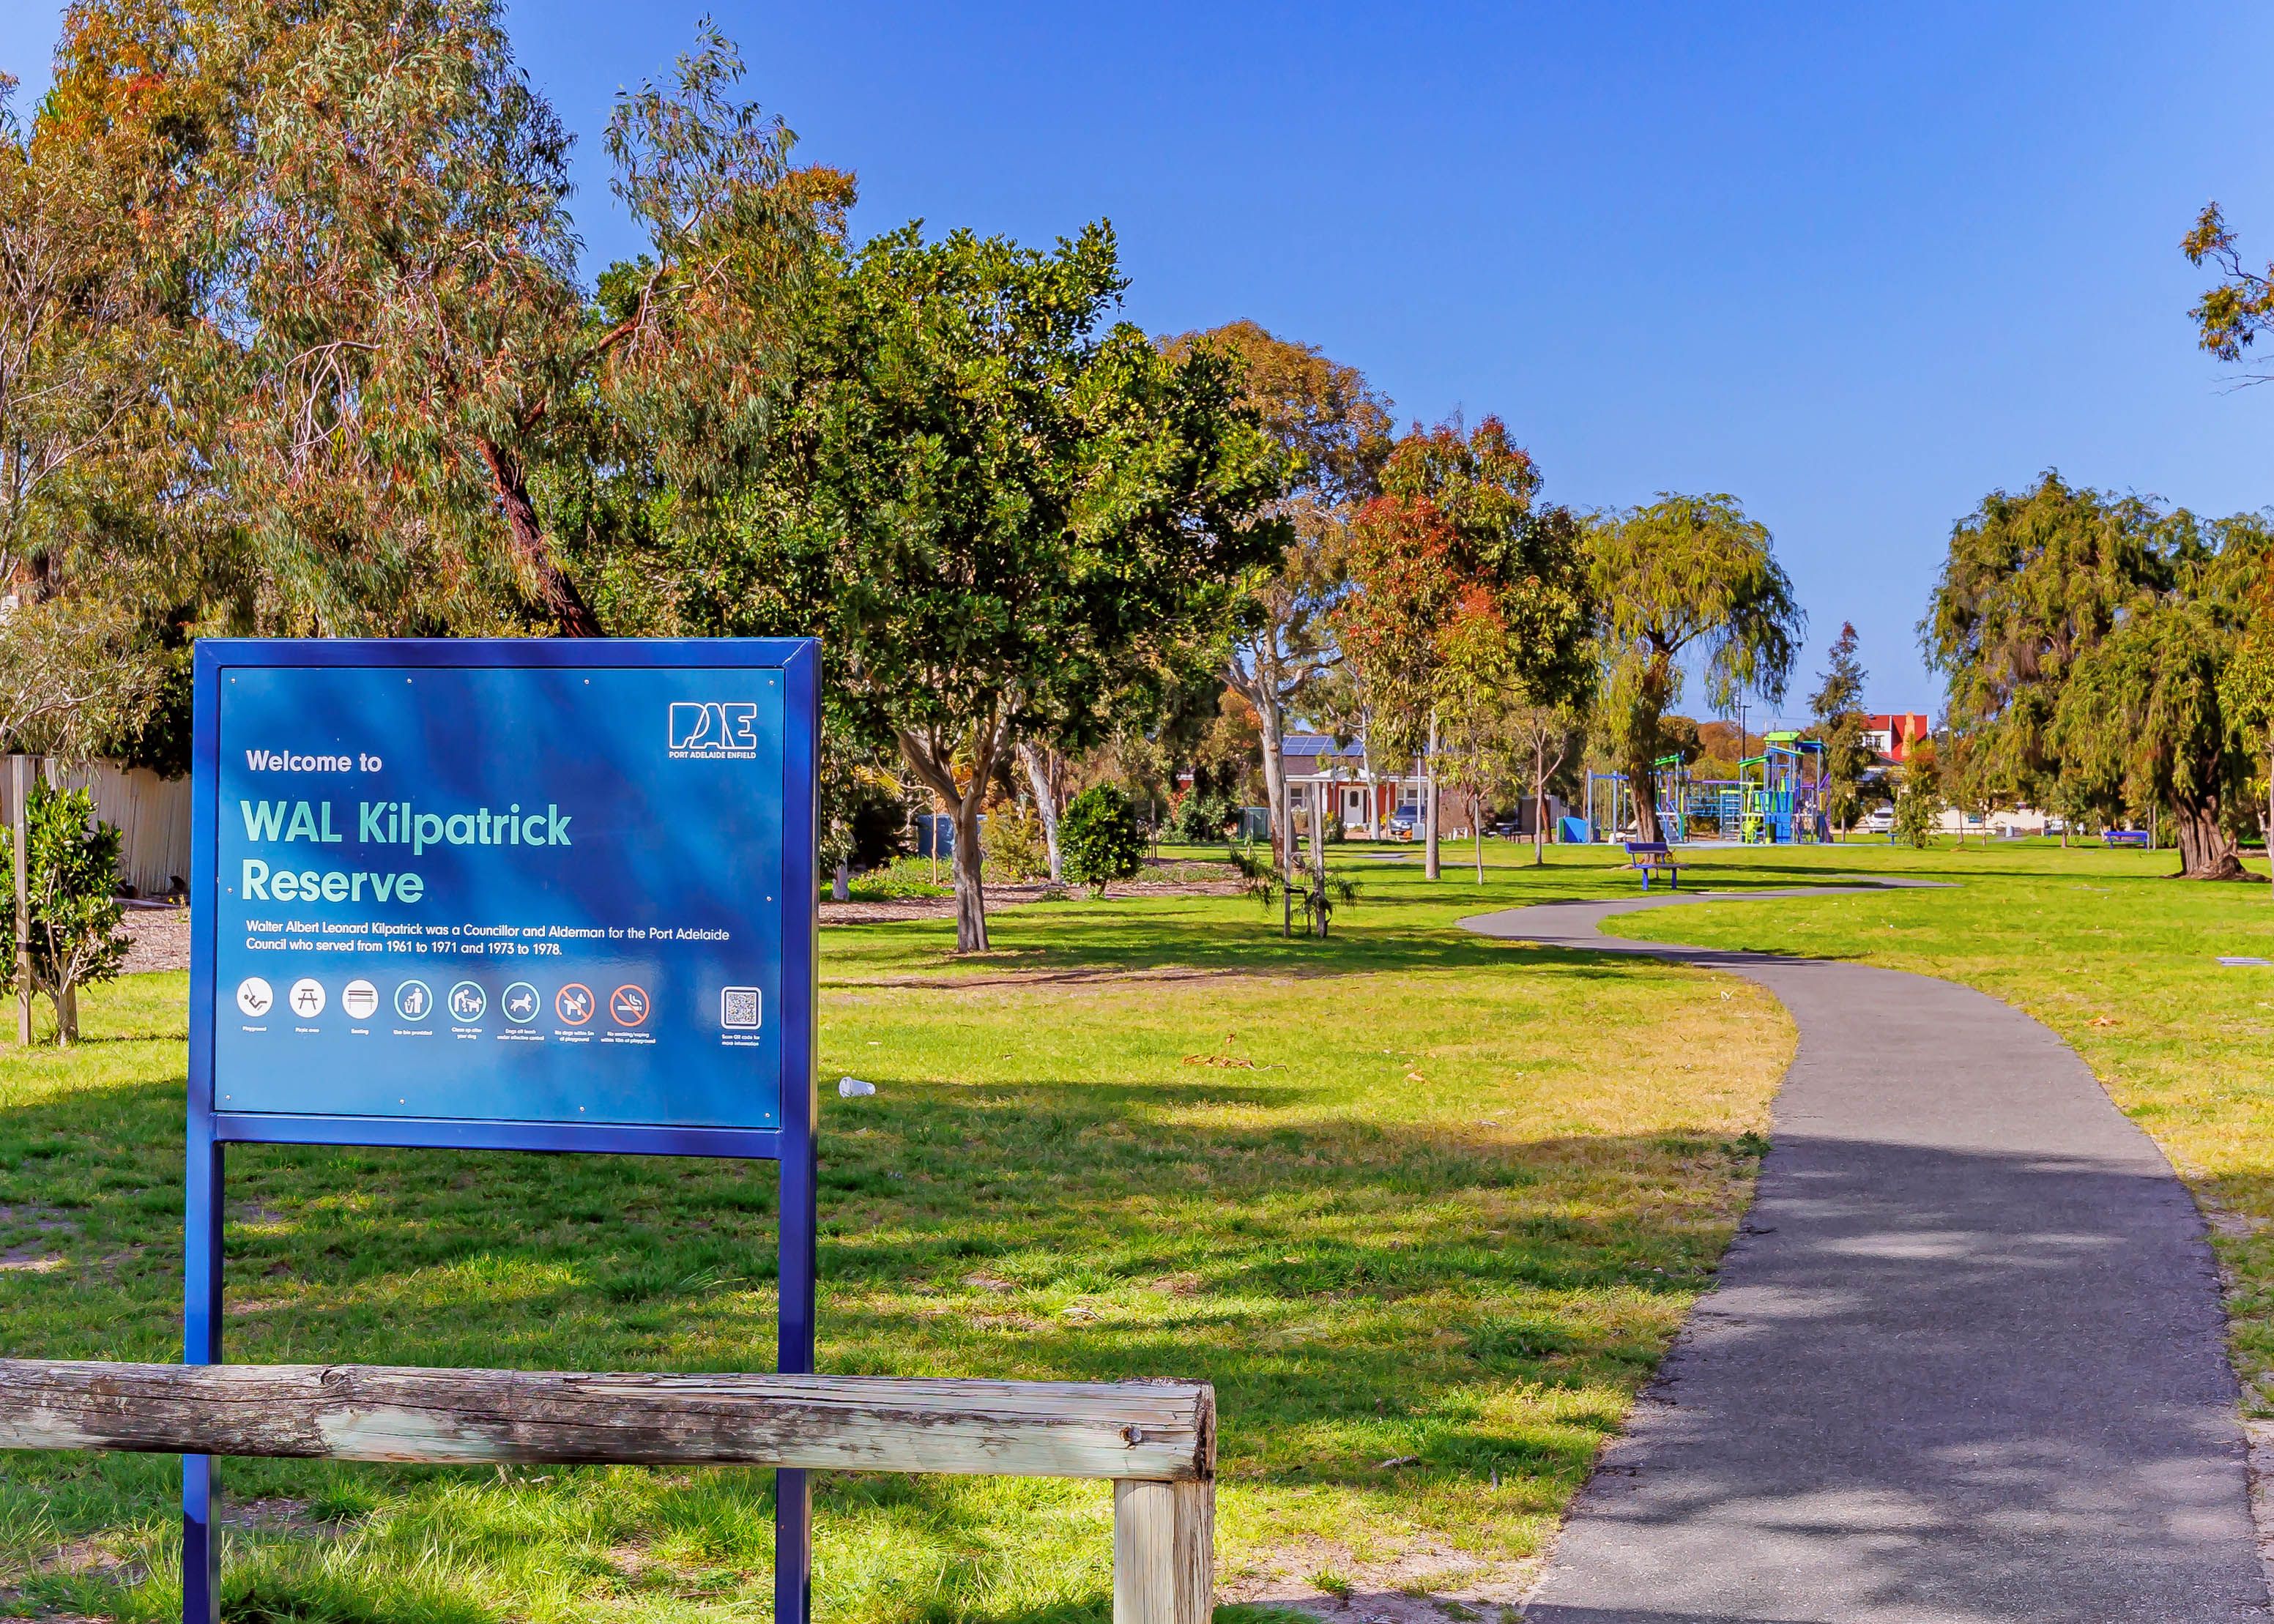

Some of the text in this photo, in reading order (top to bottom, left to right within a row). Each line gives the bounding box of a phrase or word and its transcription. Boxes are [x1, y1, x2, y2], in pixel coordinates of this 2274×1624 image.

[669, 702, 757, 750] PAE
[246, 750, 382, 772] Welcome to
[727, 751, 757, 759] ENFIELD
[240, 800, 572, 856] WAL Kilpatrick
[242, 859, 424, 904] Reserve
[245, 920, 730, 941] Walter Albert Leonard Kilpatrick was a Councillor and Alderman for the Port Adelaide
[245, 937, 562, 956] Council who served from 1961 to 1971 and 1973 to 1978.
